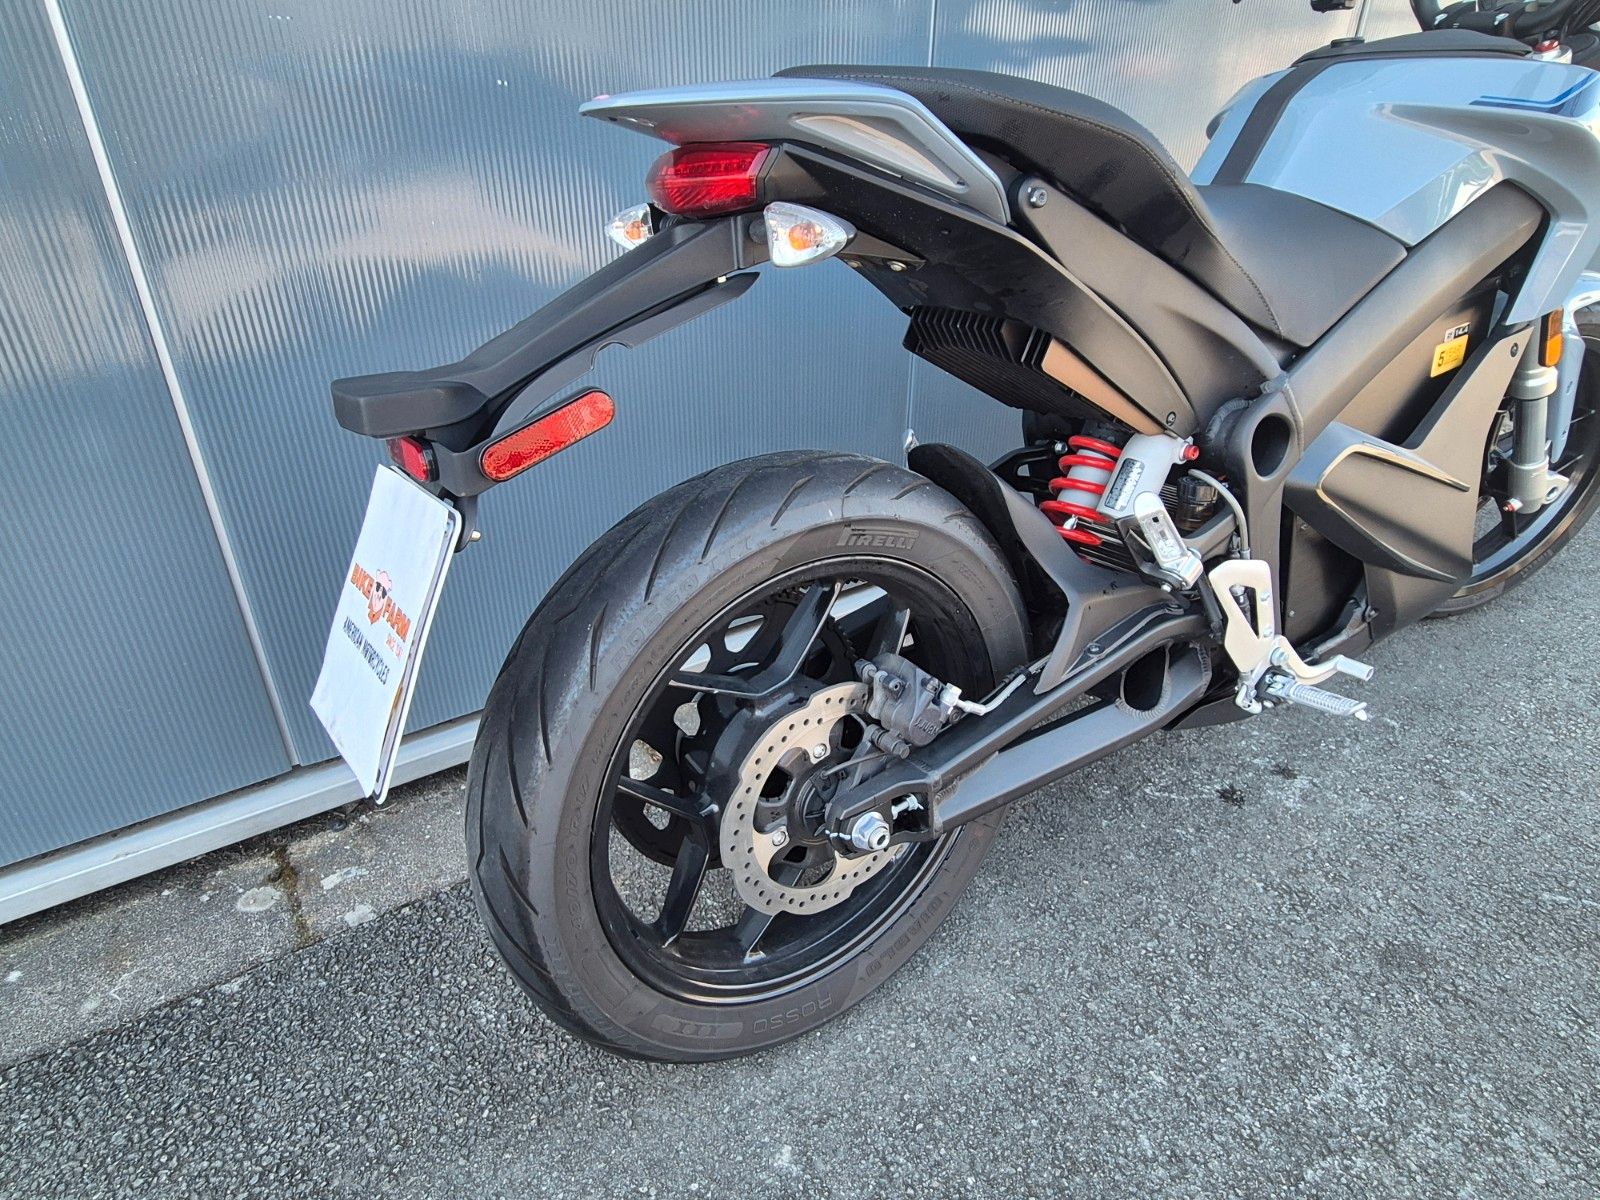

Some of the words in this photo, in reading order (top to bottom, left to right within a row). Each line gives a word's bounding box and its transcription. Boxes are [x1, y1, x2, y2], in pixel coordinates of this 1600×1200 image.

[836, 523, 920, 550] PIRELLI
[351, 563, 375, 600] BIKE
[383, 596, 411, 642] FARM
[753, 985, 832, 1034] ROSSO
